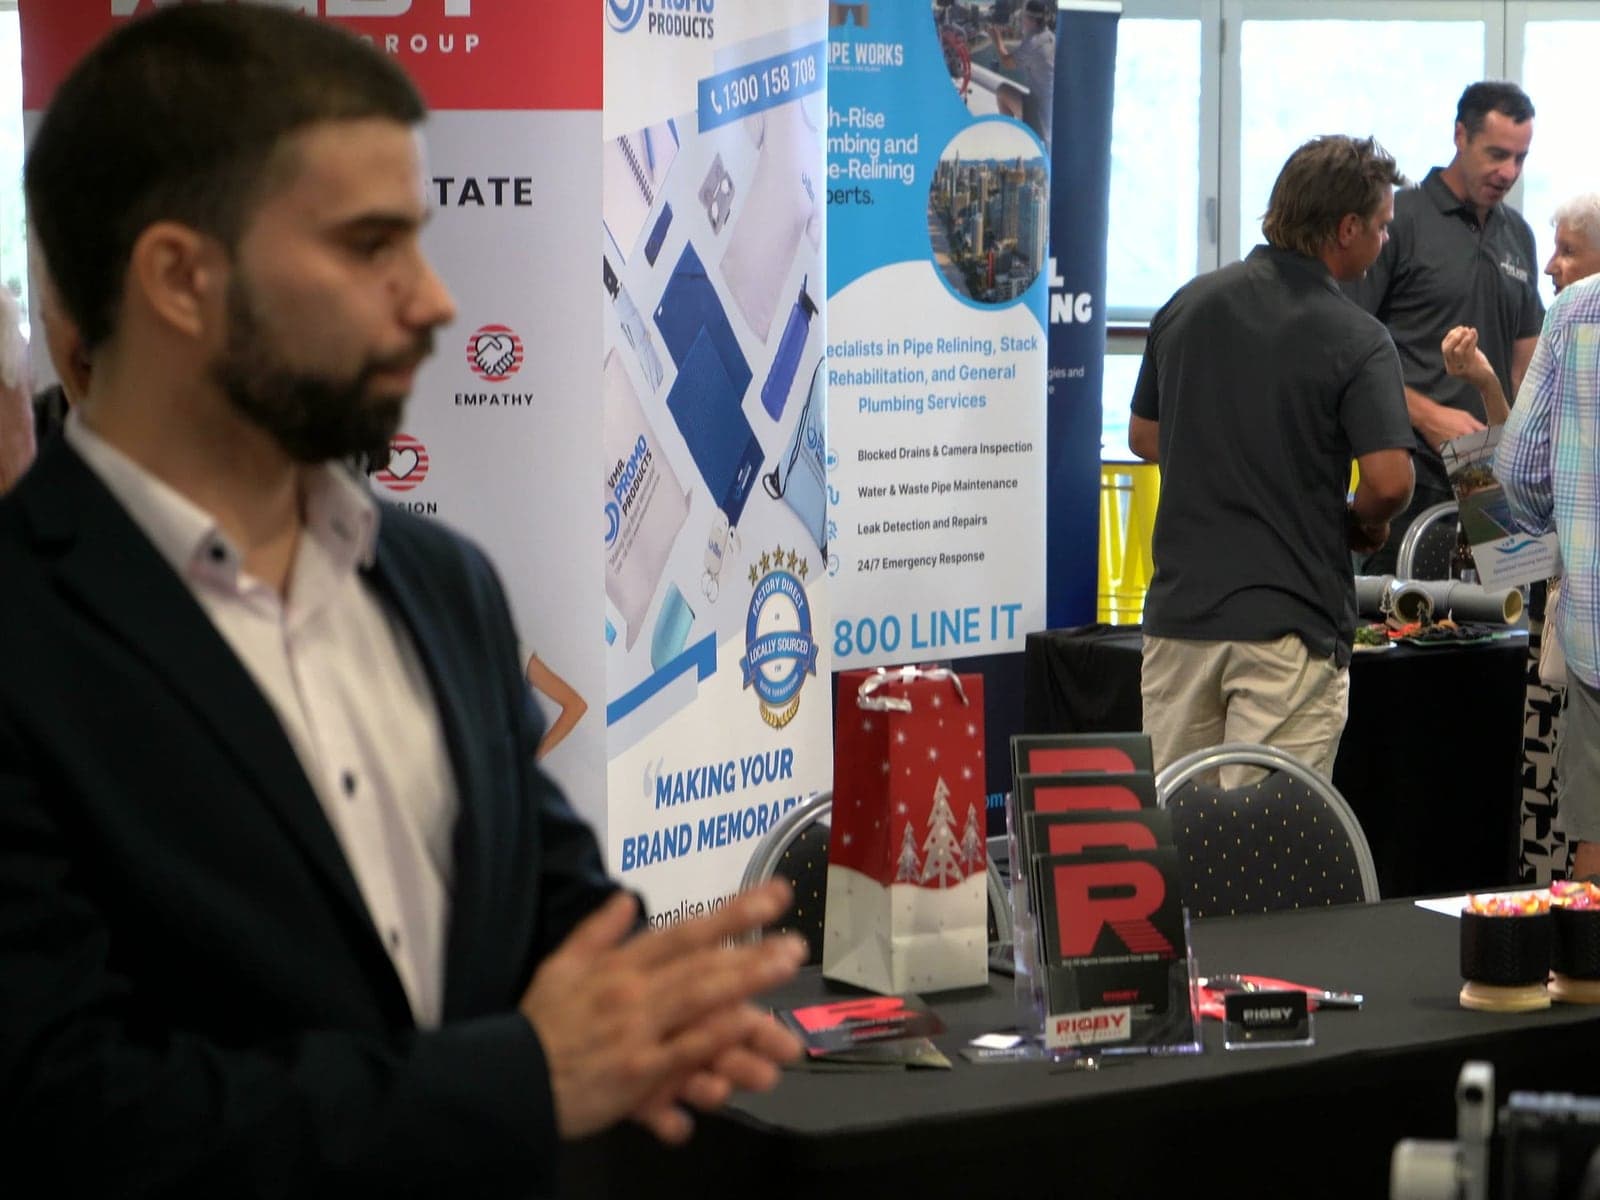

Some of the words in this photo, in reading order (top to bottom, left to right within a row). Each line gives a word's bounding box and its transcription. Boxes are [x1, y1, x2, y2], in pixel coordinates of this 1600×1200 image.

[648, 13, 714, 40] PRODUCTS
[855, 43, 903, 66] WORKS
[723, 74, 759, 111] 1300
[762, 62, 790, 97] 158
[792, 55, 816, 88] 708
[827, 106, 885, 128] h-Rise
[827, 133, 881, 159] mbing
[884, 133, 919, 154] and
[827, 158, 915, 185] e-Relining
[432, 176, 533, 206] TATE
[887, 338, 900, 356] in
[903, 337, 933, 359] Pipe
[937, 335, 997, 357] Relining,
[1000, 334, 1038, 354] Stack
[828, 367, 928, 386] Rehabilitation,
[931, 365, 956, 383] and
[959, 363, 1016, 381] General
[1068, 365, 1085, 377] and
[455, 392, 534, 406] EMPATHY
[859, 394, 924, 415] Plumbing
[927, 391, 987, 410] Services
[858, 447, 898, 463] Blocked
[899, 445, 931, 460] Drains
[933, 445, 940, 458] &
[942, 443, 978, 457] Camera
[980, 440, 1034, 456] Inspection
[608, 458, 625, 489] VMR
[614, 434, 648, 505] PROMO
[622, 448, 653, 517] PRODUCTS
[858, 483, 887, 499] Water
[889, 482, 897, 497] &
[899, 480, 930, 496] Waste
[931, 480, 953, 495] Pipe
[954, 477, 1019, 492] Maintenance
[857, 520, 881, 536] Leak
[883, 517, 931, 534] Detection
[932, 517, 951, 530] and
[952, 514, 989, 529] Repairs
[857, 557, 881, 573] 24/7
[882, 554, 937, 571] Emergency
[939, 550, 986, 566] Response
[752, 577, 781, 617] FACTORY
[781, 577, 804, 609] DIRECT
[834, 614, 900, 657] 800
[911, 606, 981, 649] LINE
[990, 603, 1023, 641] IT
[749, 638, 777, 665] LOCALLY
[777, 638, 809, 655] SOURCED
[655, 759, 736, 810] MAKING
[740, 747, 794, 789] YOUR
[621, 823, 693, 873] BRAND
[697, 791, 820, 852] MEMORA
[1056, 1013, 1126, 1035] RIGBY
